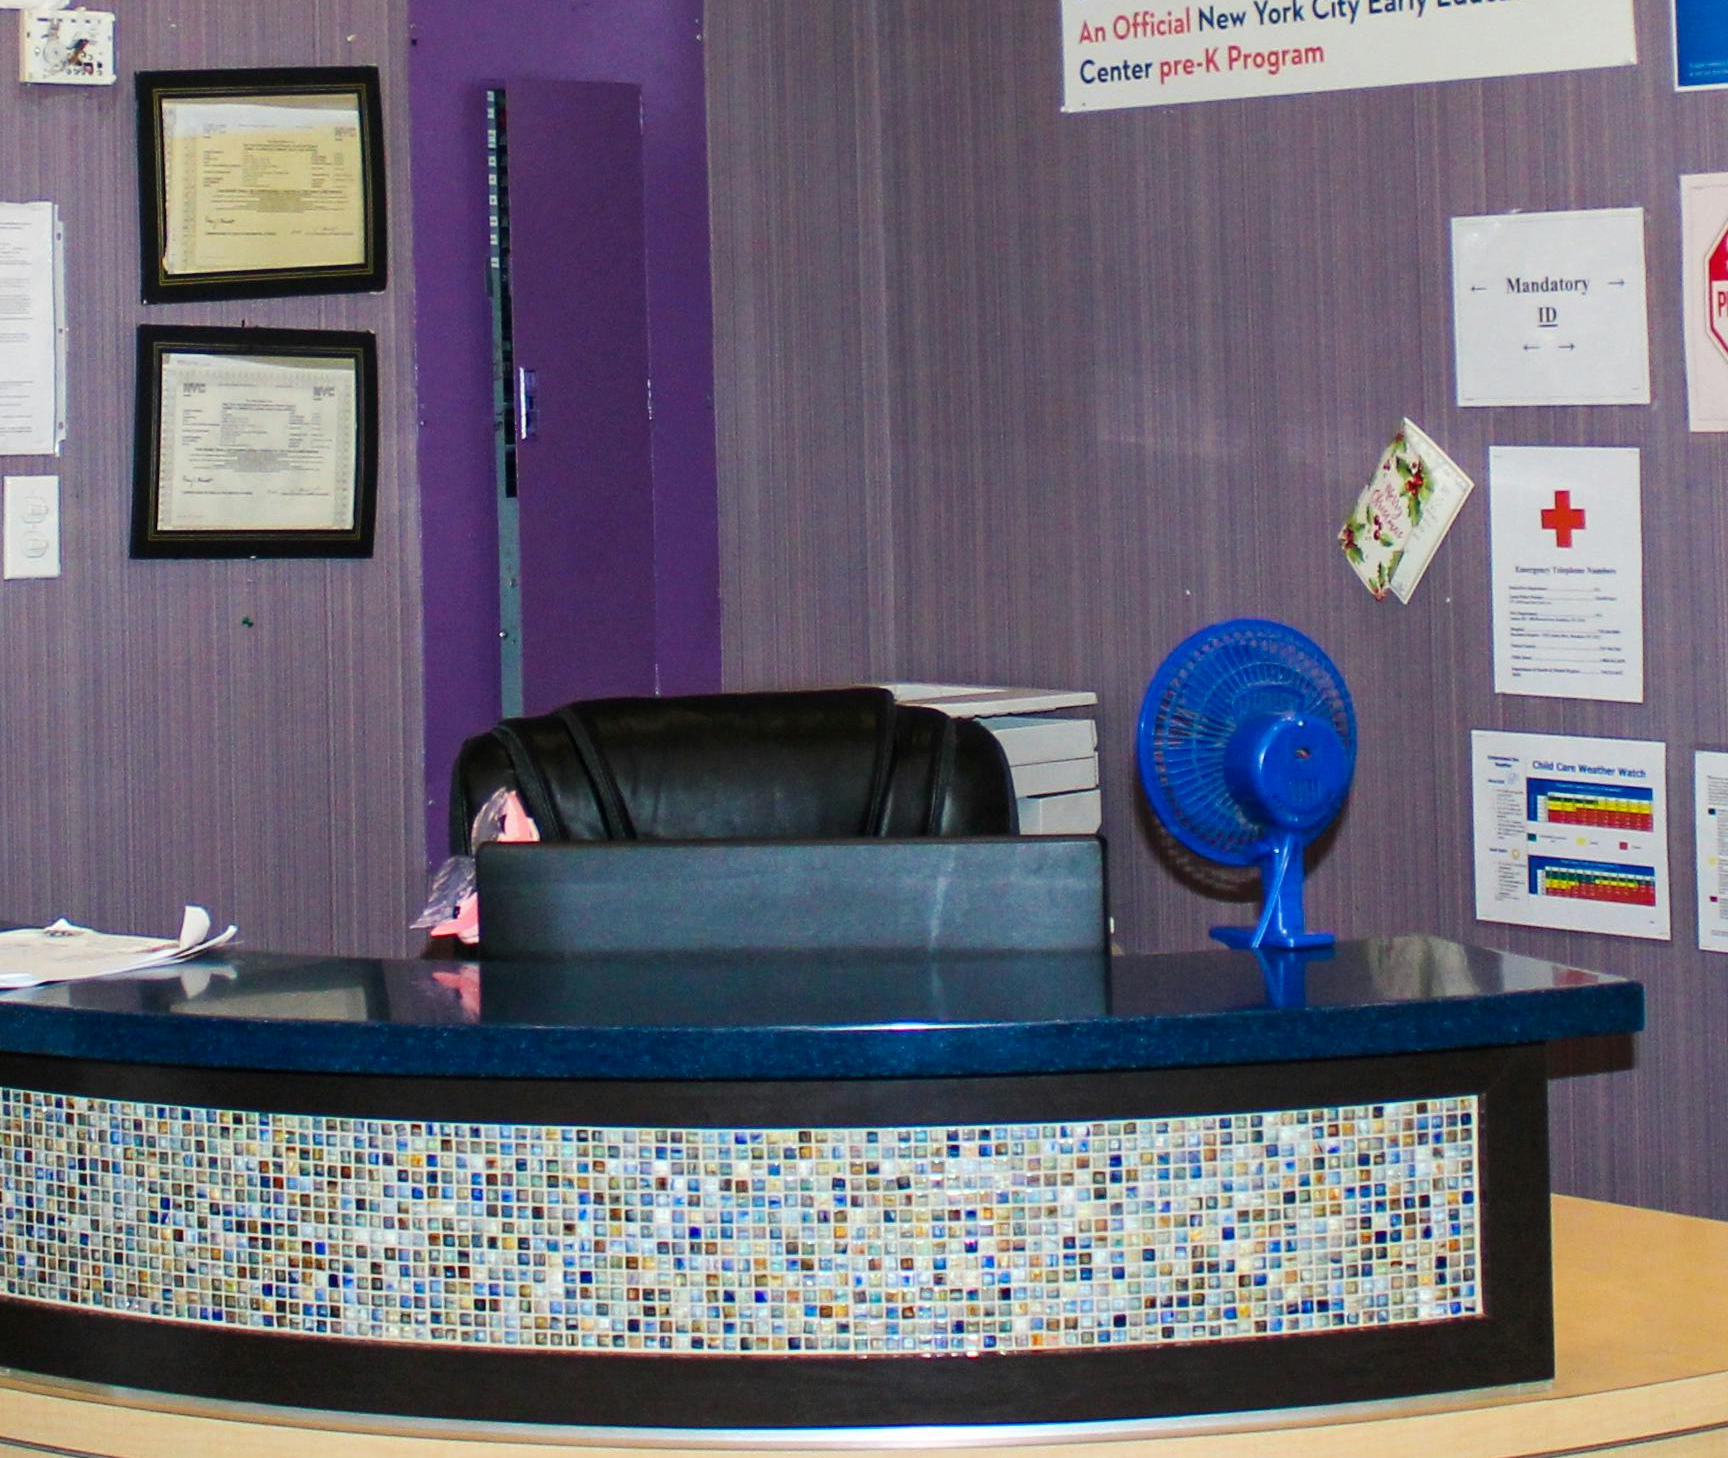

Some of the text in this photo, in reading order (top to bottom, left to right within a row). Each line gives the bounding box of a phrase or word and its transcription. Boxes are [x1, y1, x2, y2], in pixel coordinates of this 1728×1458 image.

[1079, 21, 1106, 44] An
[1113, 6, 1191, 41] Official
[1198, 3, 1246, 34] New
[1079, 41, 1325, 86] Center pre-K Program
[1506, 276, 1590, 295] Mandatory
[1537, 306, 1557, 324] ID
[1515, 566, 1550, 574] Emergency
[1532, 760, 1646, 778] Child Care Weather Watch
